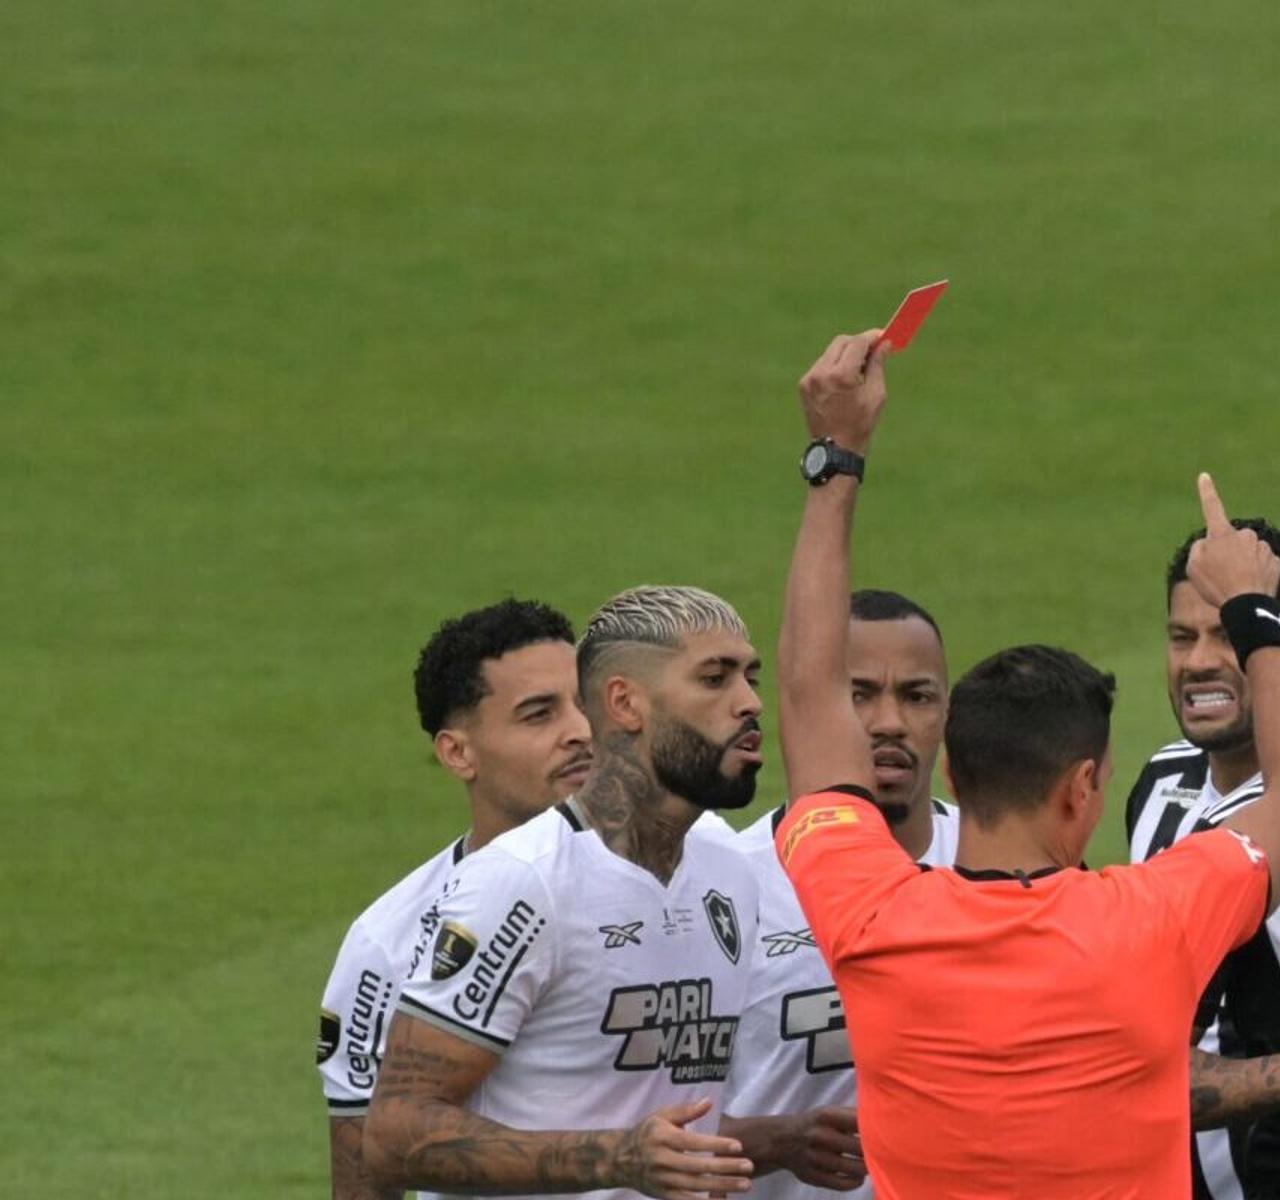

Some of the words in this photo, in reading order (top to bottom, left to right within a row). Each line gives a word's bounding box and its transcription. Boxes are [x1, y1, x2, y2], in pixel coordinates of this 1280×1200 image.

[452, 899, 537, 1021] Centrum
[603, 980, 711, 1031] PARI
[345, 968, 382, 1091] Centrum
